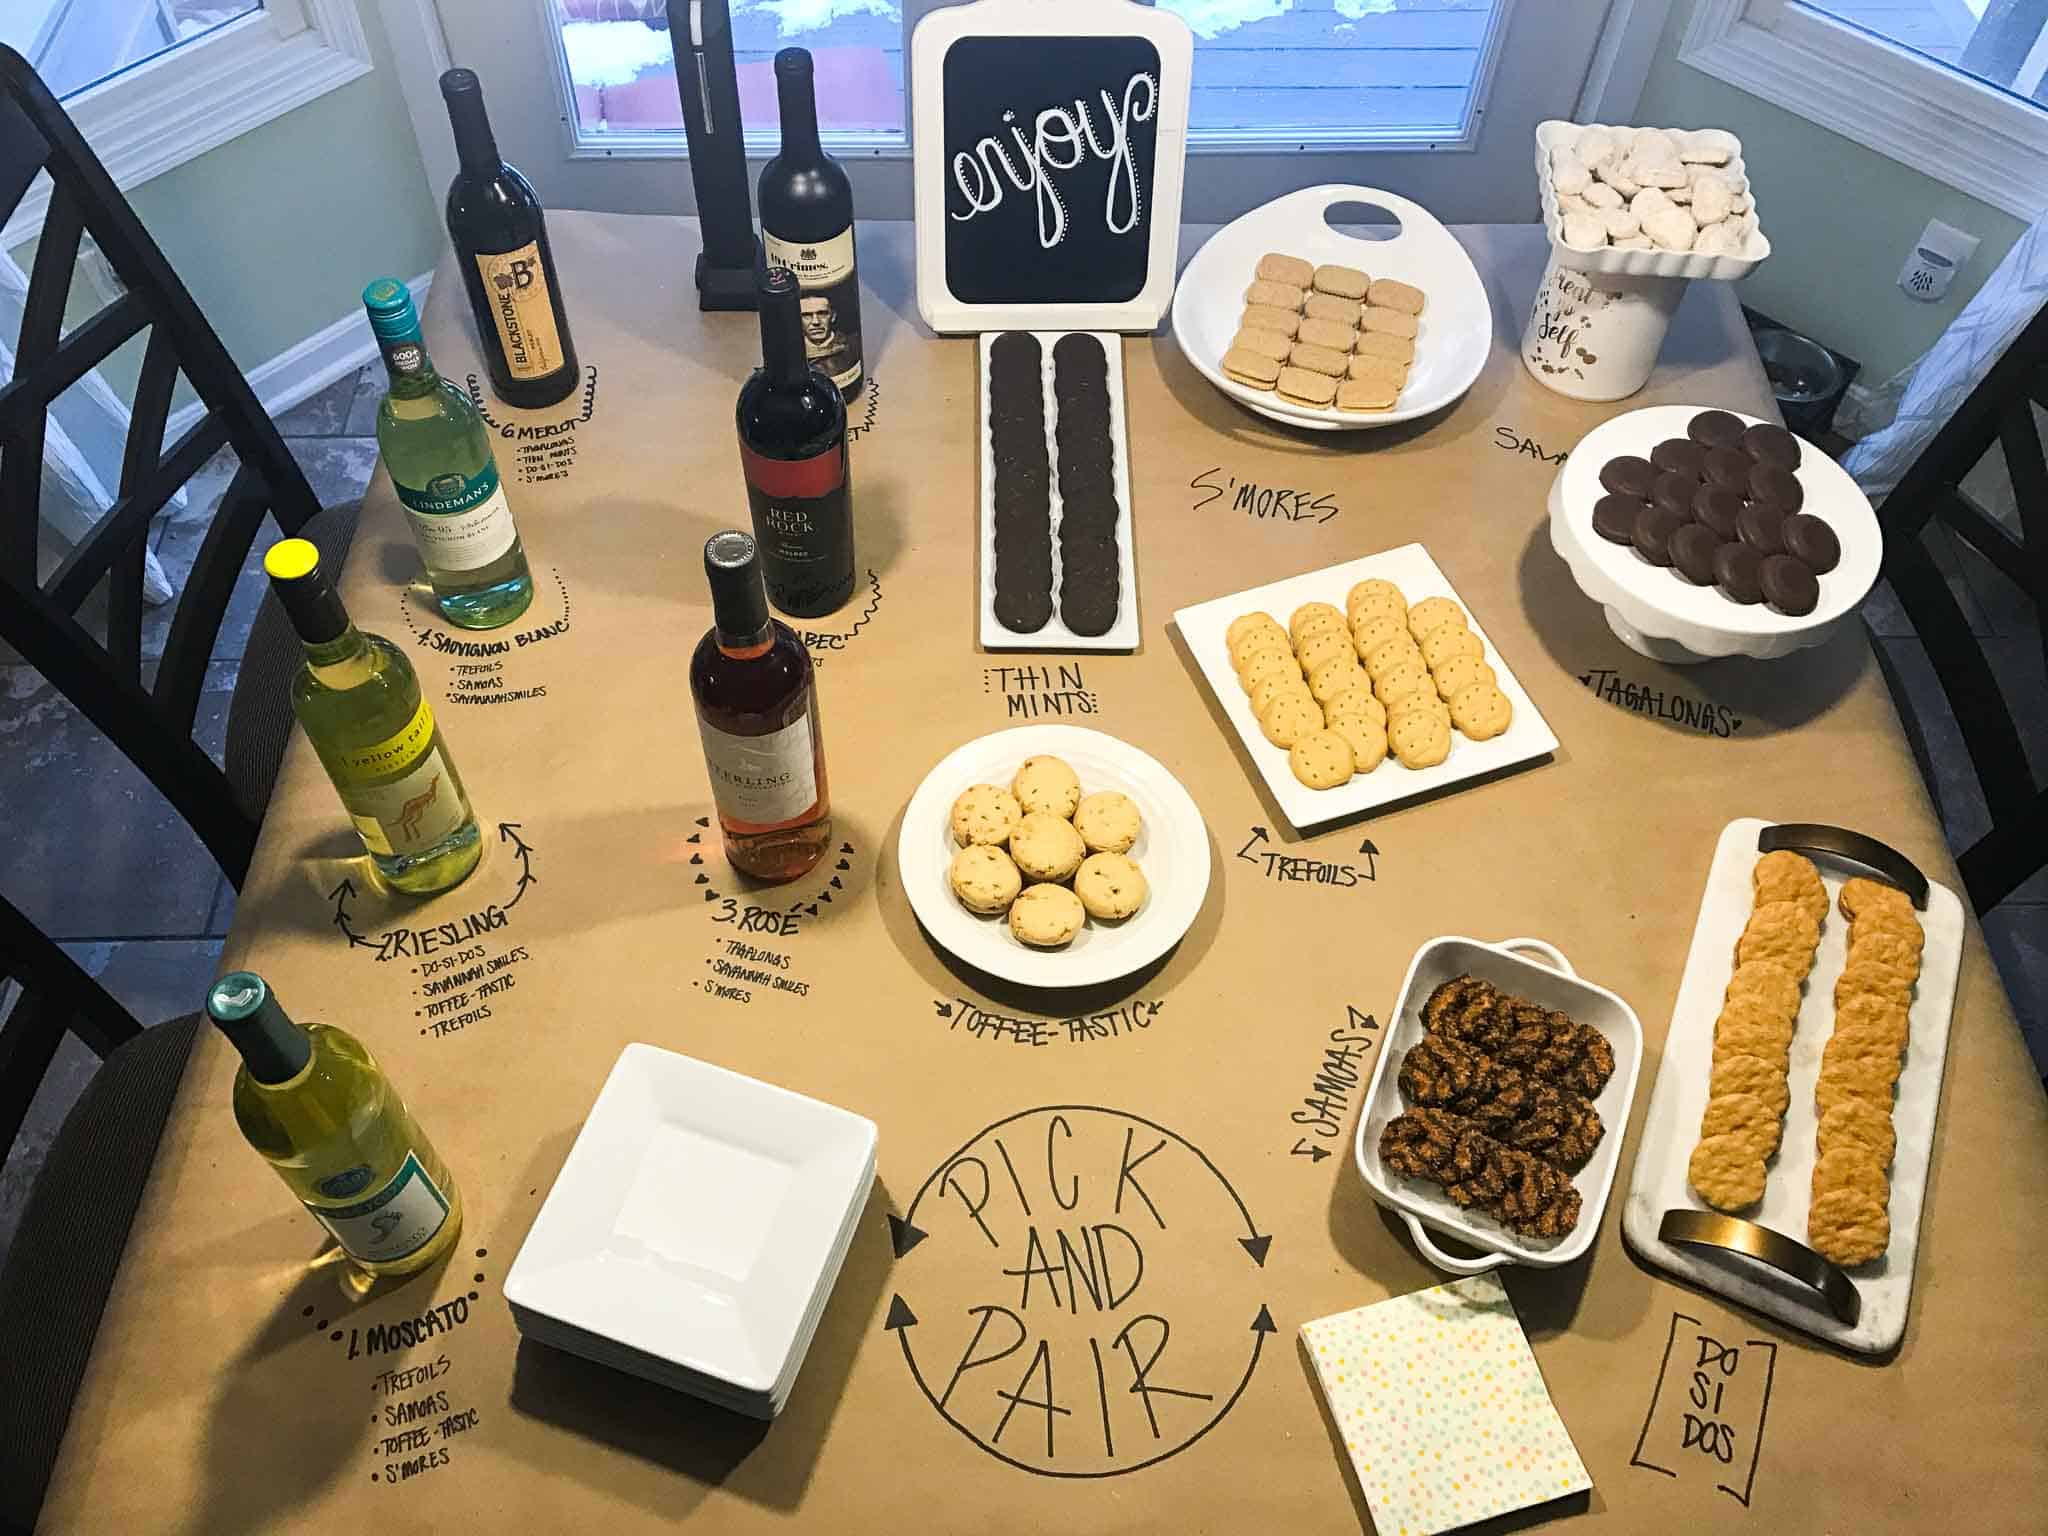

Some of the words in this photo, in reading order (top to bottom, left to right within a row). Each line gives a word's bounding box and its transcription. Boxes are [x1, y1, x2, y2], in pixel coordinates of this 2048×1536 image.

[951, 71, 1158, 249] enjoy
[497, 289, 528, 365] BLACKSTONE
[517, 419, 577, 440] MERLOT
[769, 506, 808, 523] RED
[1190, 466, 1340, 524] S'MORES
[766, 515, 816, 534] ROCK
[430, 632, 511, 658] SAUVIGNON
[513, 620, 570, 648] BLANC
[797, 630, 846, 651] BEC
[457, 676, 504, 691] SAMOAS
[990, 662, 1083, 692] THIN
[1007, 690, 1093, 719] MINTS
[1588, 669, 1733, 738] TAGALONGS
[1260, 852, 1358, 888] TREFOILS
[392, 904, 508, 958] RIESLING
[711, 898, 737, 923] 3.
[737, 902, 803, 937] ROSÉ
[421, 944, 486, 977] DO-SI-DOS
[422, 964, 485, 997] SAVANNAH
[486, 946, 530, 975] SMILES
[725, 939, 791, 970] TAGALONGS
[703, 978, 752, 1004] S'MORES
[712, 958, 772, 986] SAVANNAH
[772, 975, 810, 997] SMILES
[429, 1004, 493, 1038] TREFOILS
[1291, 1028, 1374, 1138] SAMOAS
[939, 1115, 1168, 1249] PICK
[1002, 1223, 1144, 1315] AND
[366, 1296, 469, 1357] MOSCATO
[375, 1354, 451, 1396] TREFOILS
[1696, 1335, 1740, 1377] DO
[938, 1305, 1214, 1458] PAIR
[1689, 1371, 1724, 1415] SI
[384, 1390, 450, 1427] SAMOAS
[1681, 1413, 1735, 1464] DOS
[384, 1447, 451, 1485] S'MORES
